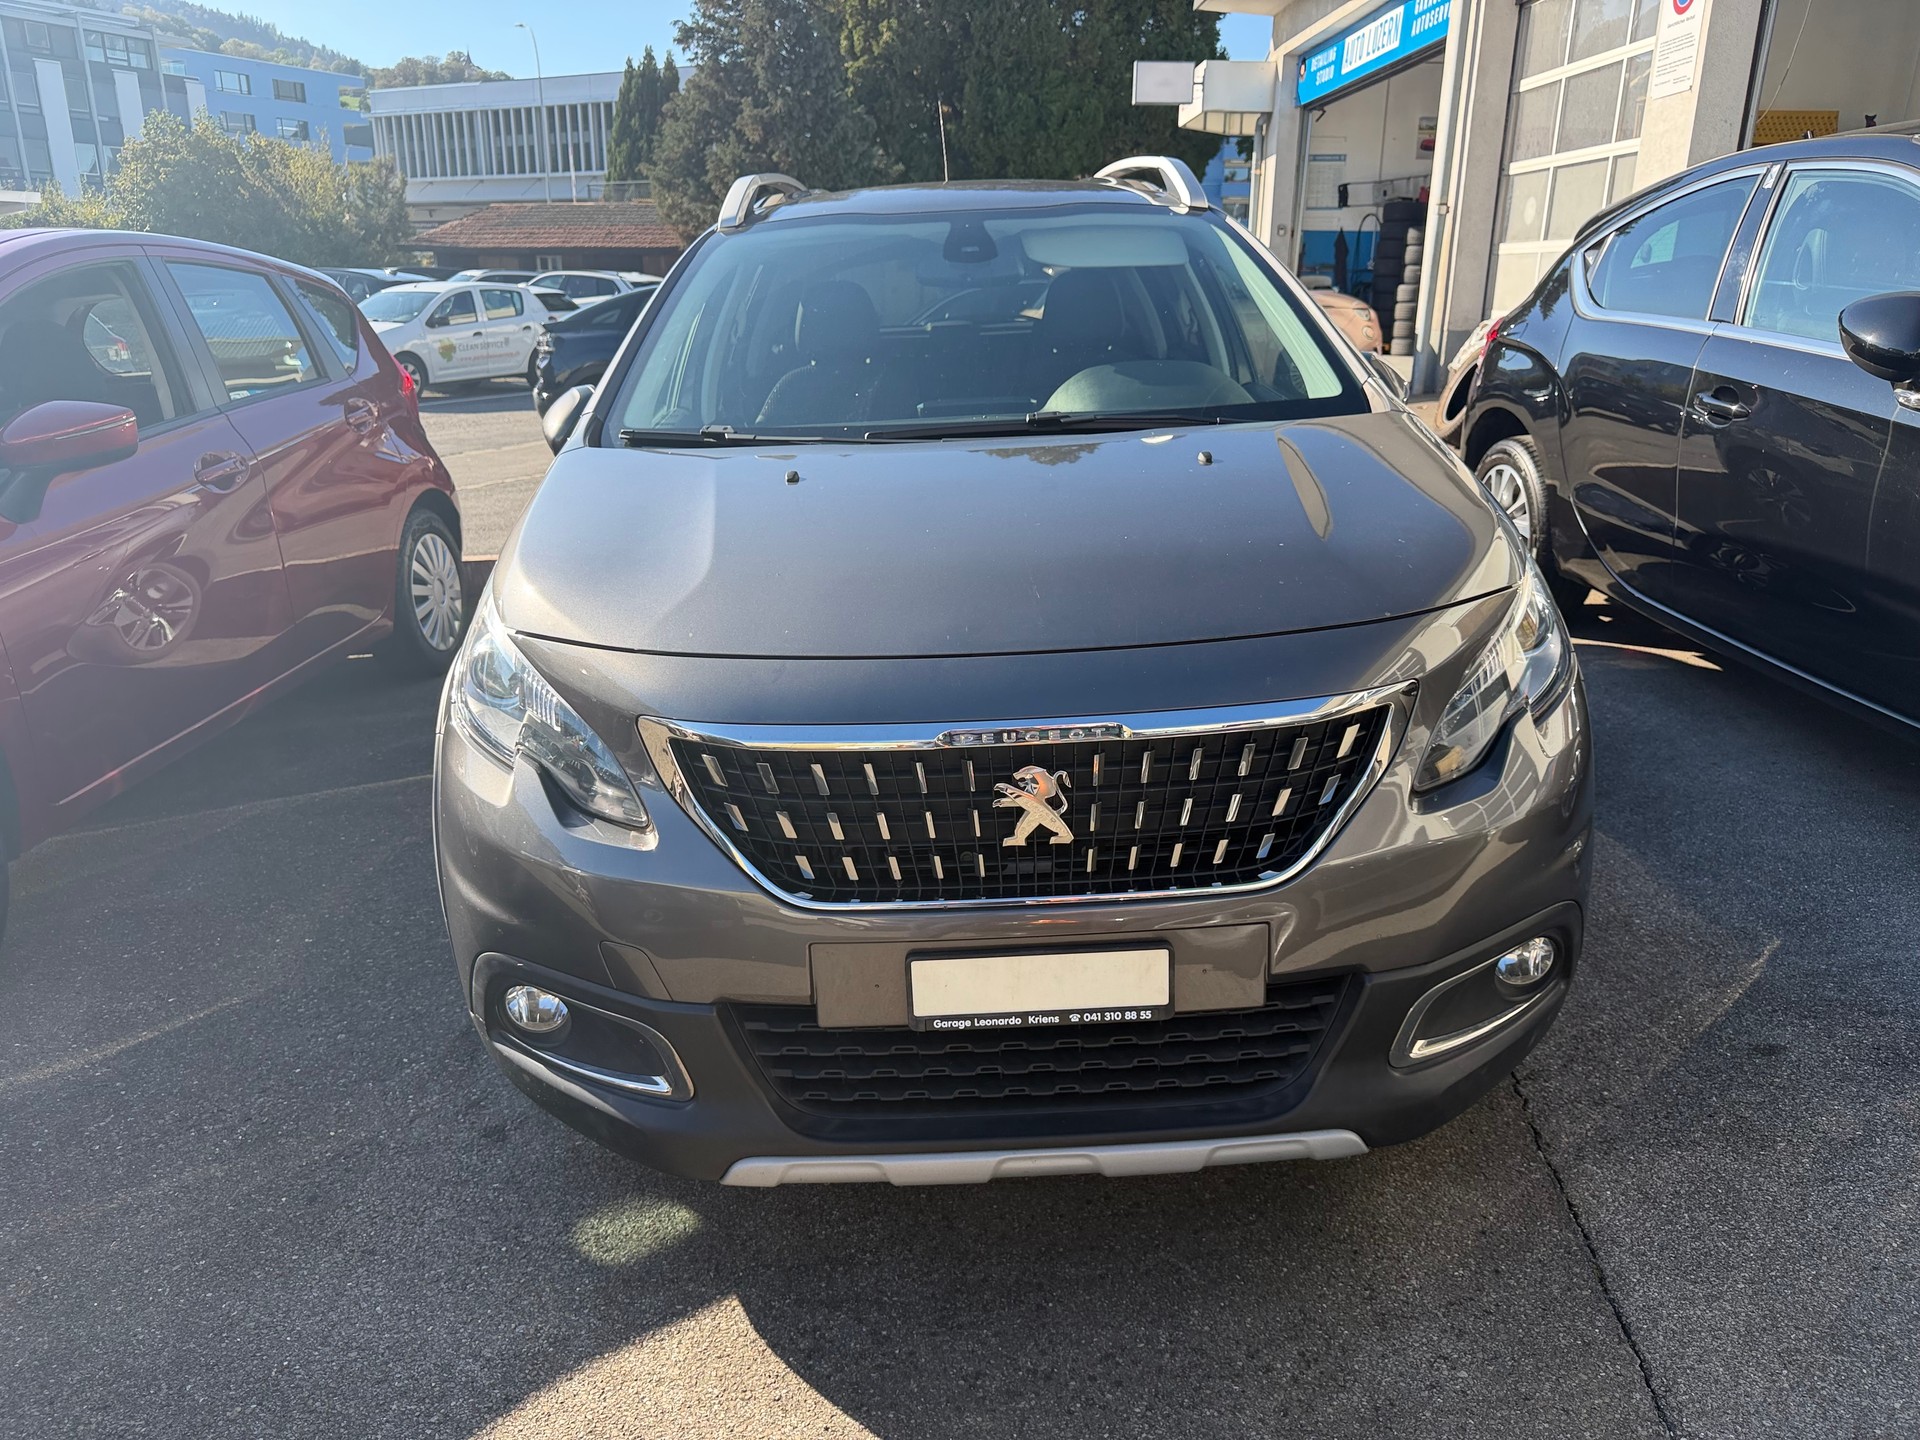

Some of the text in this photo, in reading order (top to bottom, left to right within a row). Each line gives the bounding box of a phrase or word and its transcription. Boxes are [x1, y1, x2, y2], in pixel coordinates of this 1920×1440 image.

[1410, 1, 1451, 38] AUTOSERV
[1343, 11, 1402, 68] AUTO LUZERN
[1310, 46, 1337, 72] DETAILING
[1315, 64, 1335, 86] STUDIO
[458, 340, 504, 352] CLEAN SERVICE
[958, 727, 1106, 746] PEUGEOT
[933, 1010, 1152, 1030] Garage Leonardo Kriens 041 310 88 55
